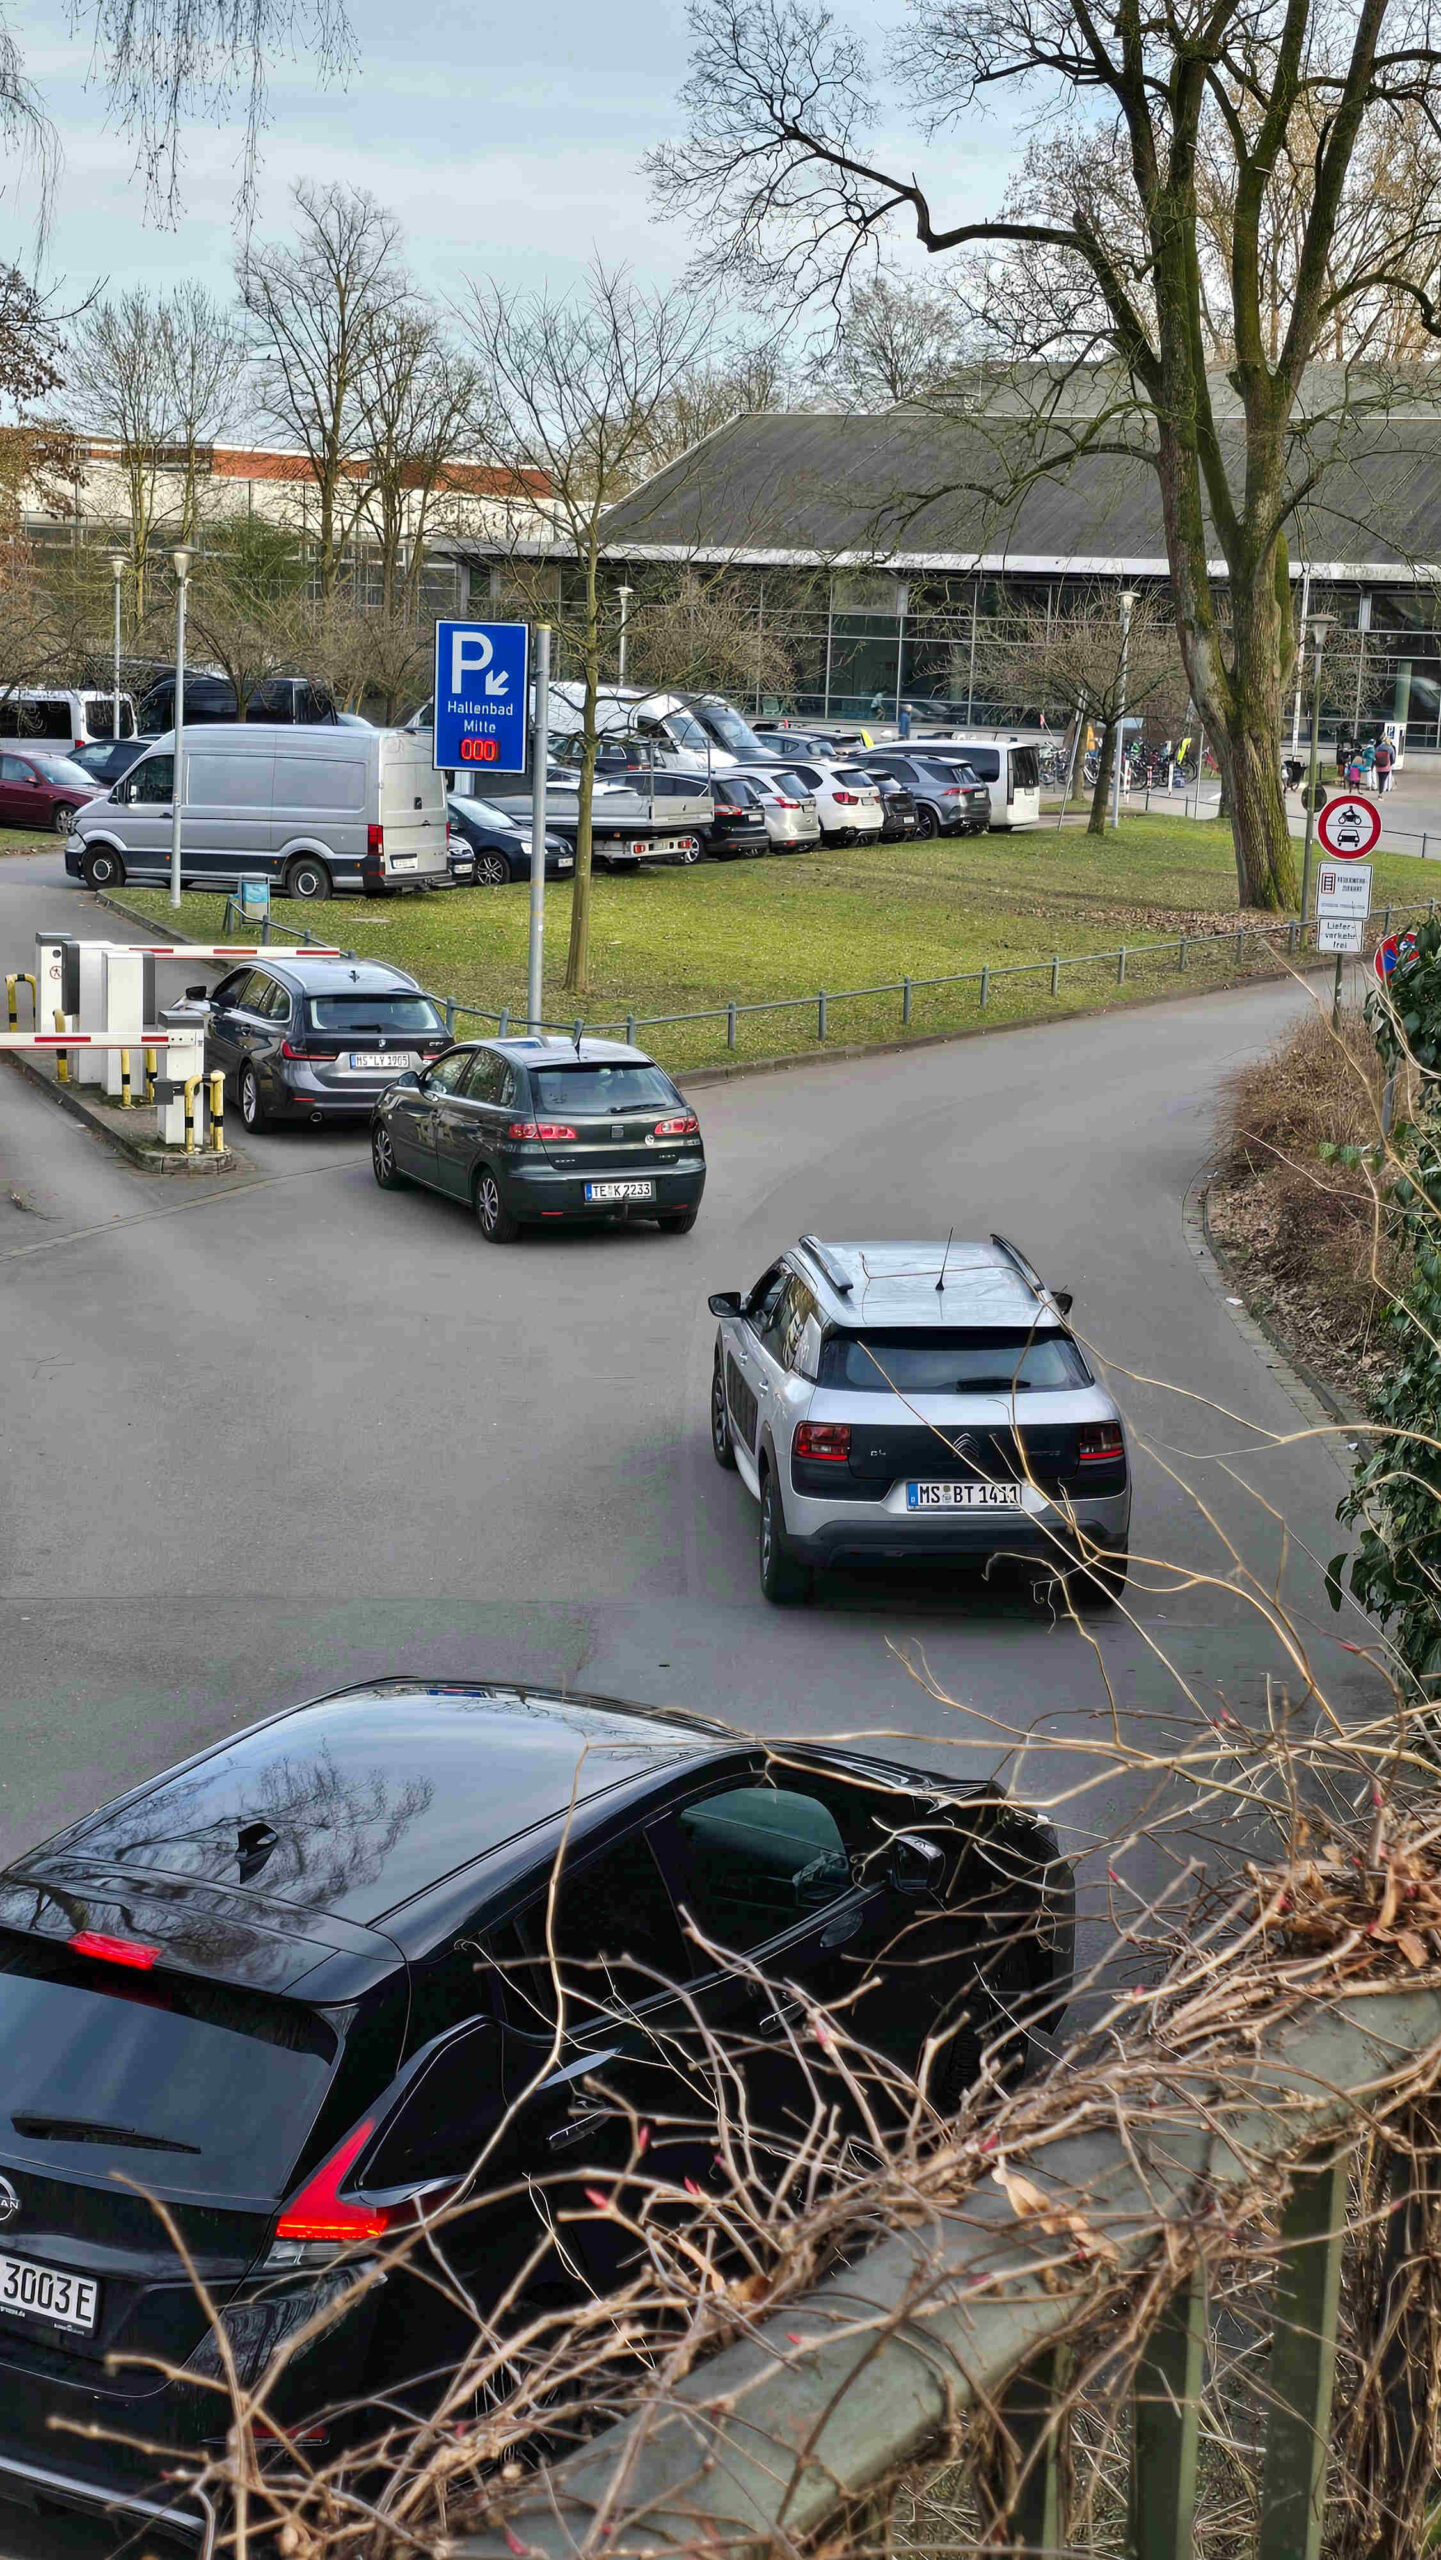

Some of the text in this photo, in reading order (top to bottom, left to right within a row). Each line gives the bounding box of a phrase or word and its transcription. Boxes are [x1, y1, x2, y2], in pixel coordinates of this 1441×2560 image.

[451, 631, 494, 695] P
[447, 700, 514, 716] Hallenbad
[1333, 941, 1348, 949] frei
[356, 1056, 368, 1066] MS
[592, 1183, 650, 1197] TE K 2233
[919, 1485, 940, 1504] MS
[953, 1485, 974, 1504] BT
[3, 2261, 94, 2322] 3003E
